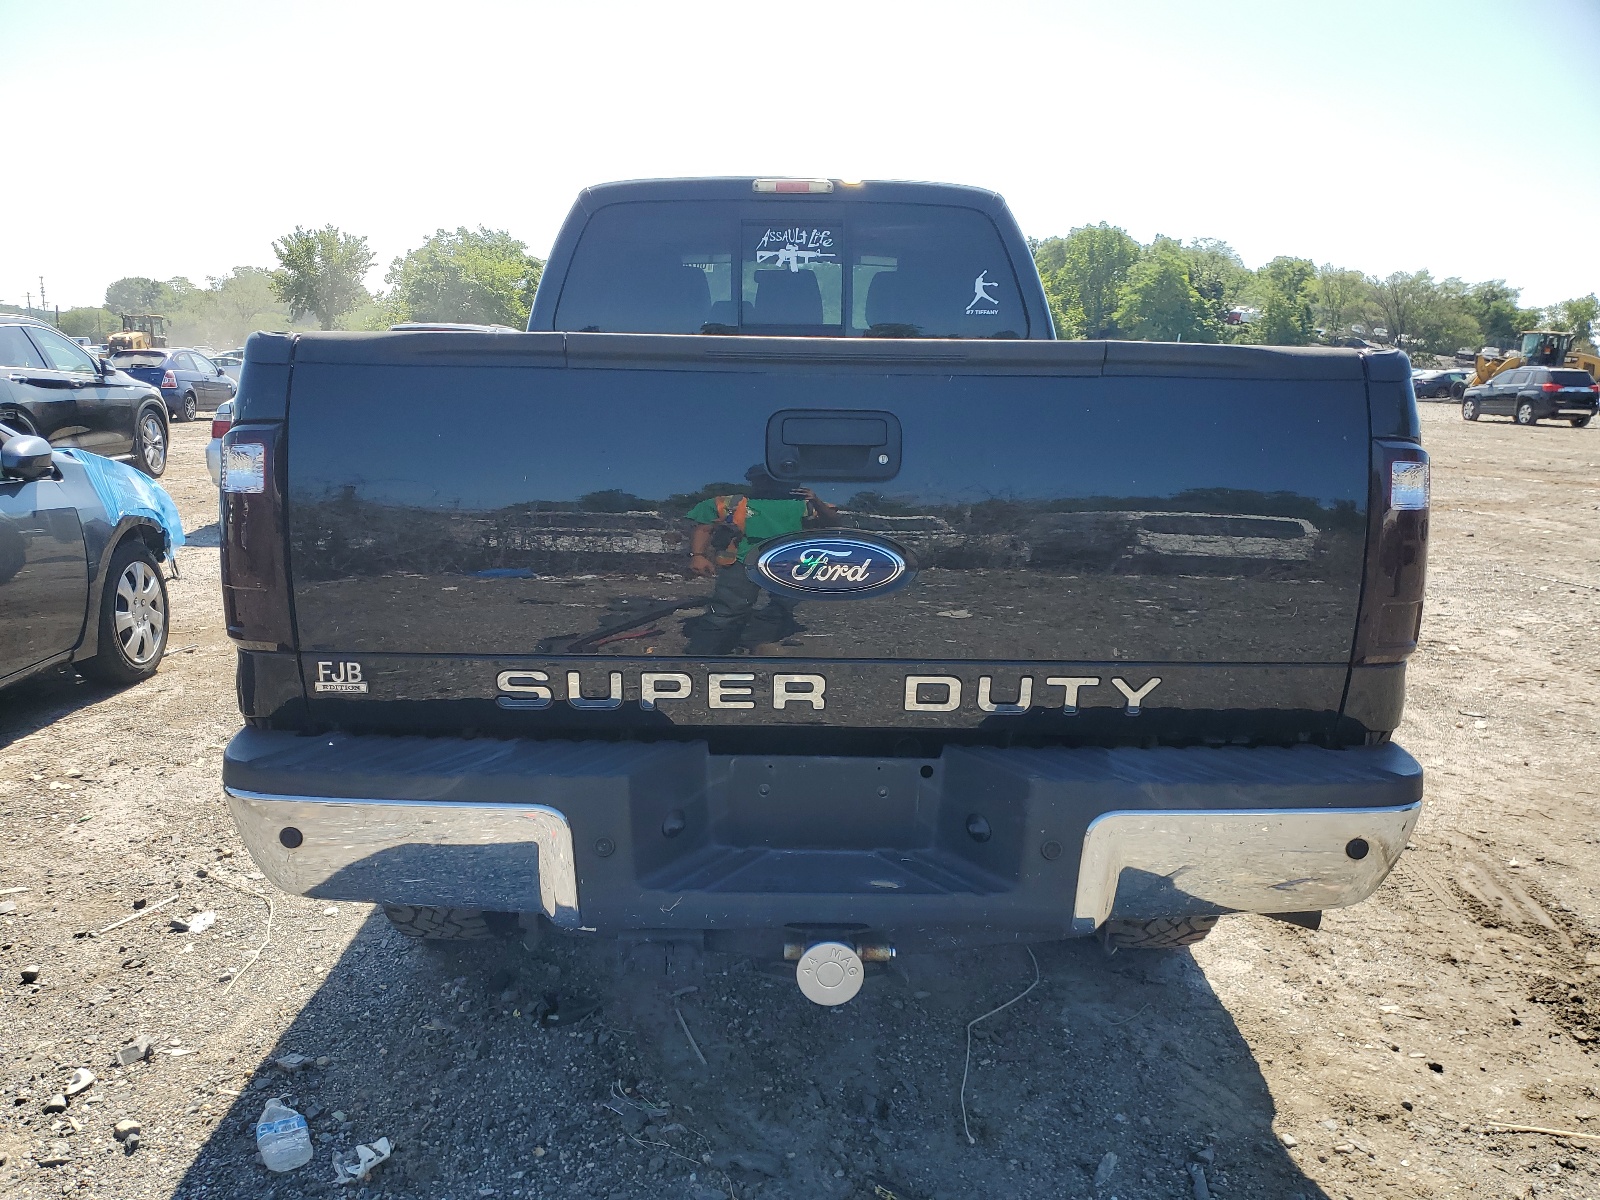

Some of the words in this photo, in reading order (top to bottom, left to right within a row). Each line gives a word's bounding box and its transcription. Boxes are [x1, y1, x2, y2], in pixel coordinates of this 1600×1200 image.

[791, 548, 872, 581] Ford
[317, 661, 362, 682] FJB
[496, 670, 827, 711] SUPER
[904, 675, 1163, 715] DUTY
[830, 948, 859, 976] MAG
